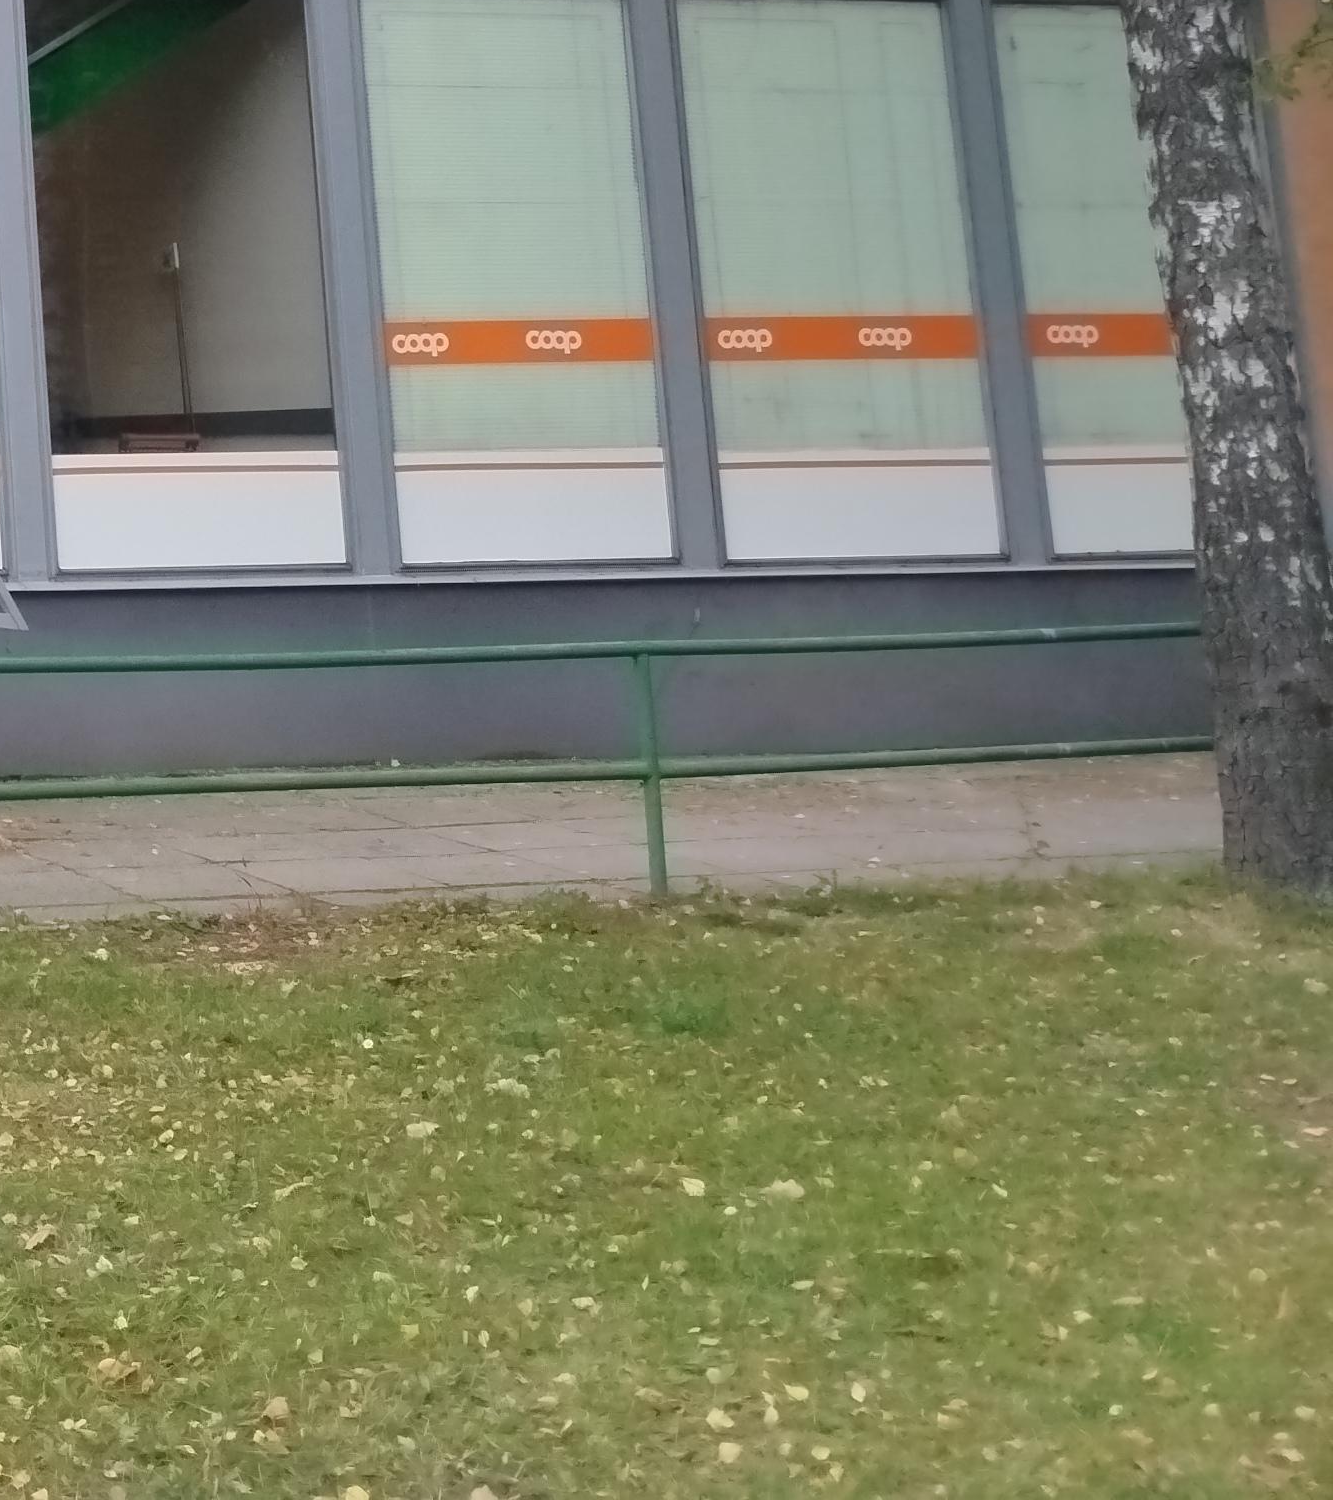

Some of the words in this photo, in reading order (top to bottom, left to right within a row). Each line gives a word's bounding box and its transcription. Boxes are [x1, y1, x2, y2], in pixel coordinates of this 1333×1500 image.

[392, 332, 449, 357] coop
[525, 330, 582, 355] coop
[717, 328, 773, 353] coop
[858, 327, 912, 351] coop
[1046, 324, 1099, 348] coop
